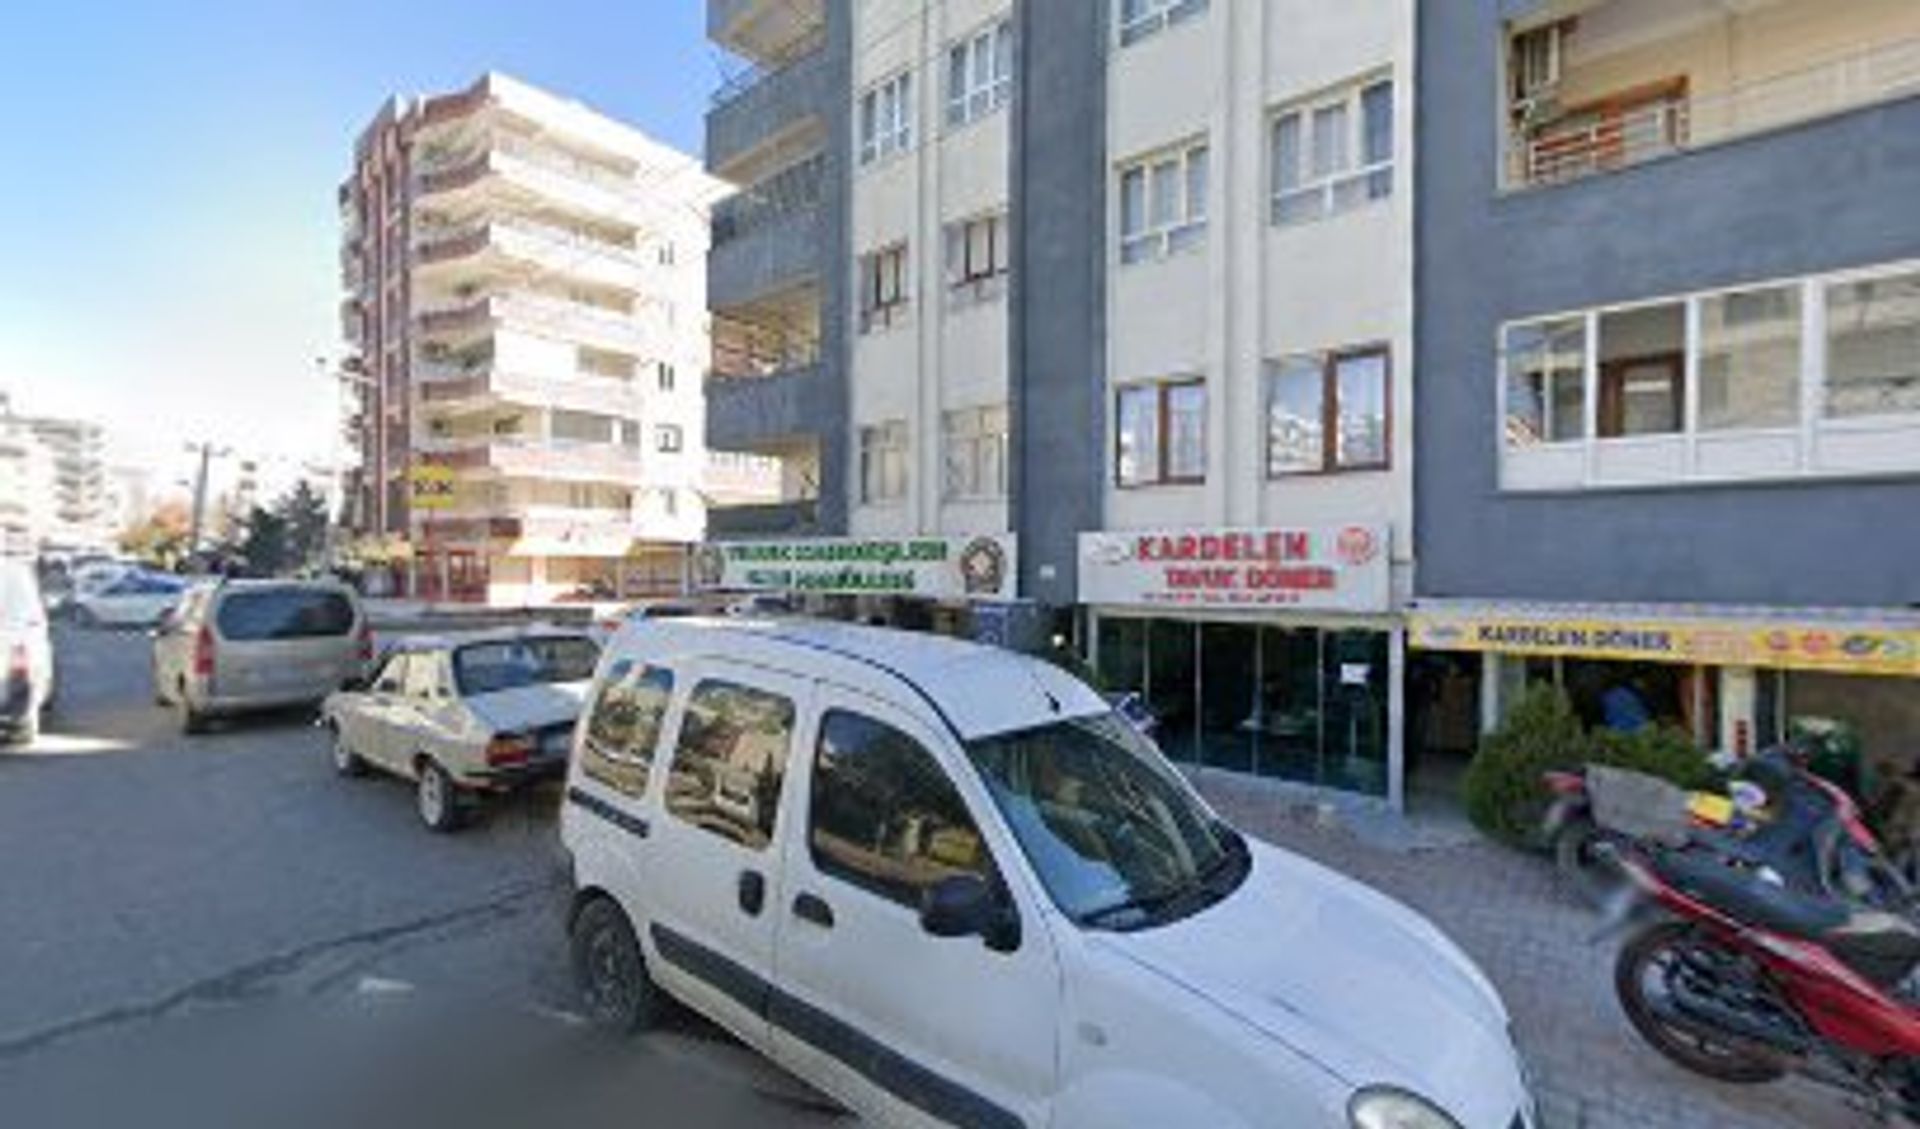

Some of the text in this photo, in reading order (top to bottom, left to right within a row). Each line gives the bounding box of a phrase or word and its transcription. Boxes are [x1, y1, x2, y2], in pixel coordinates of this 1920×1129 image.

[1137, 532, 1310, 561] KARDELEN
[1164, 567, 1236, 589] TAVUK
[1478, 625, 1588, 647] KARDELEN
